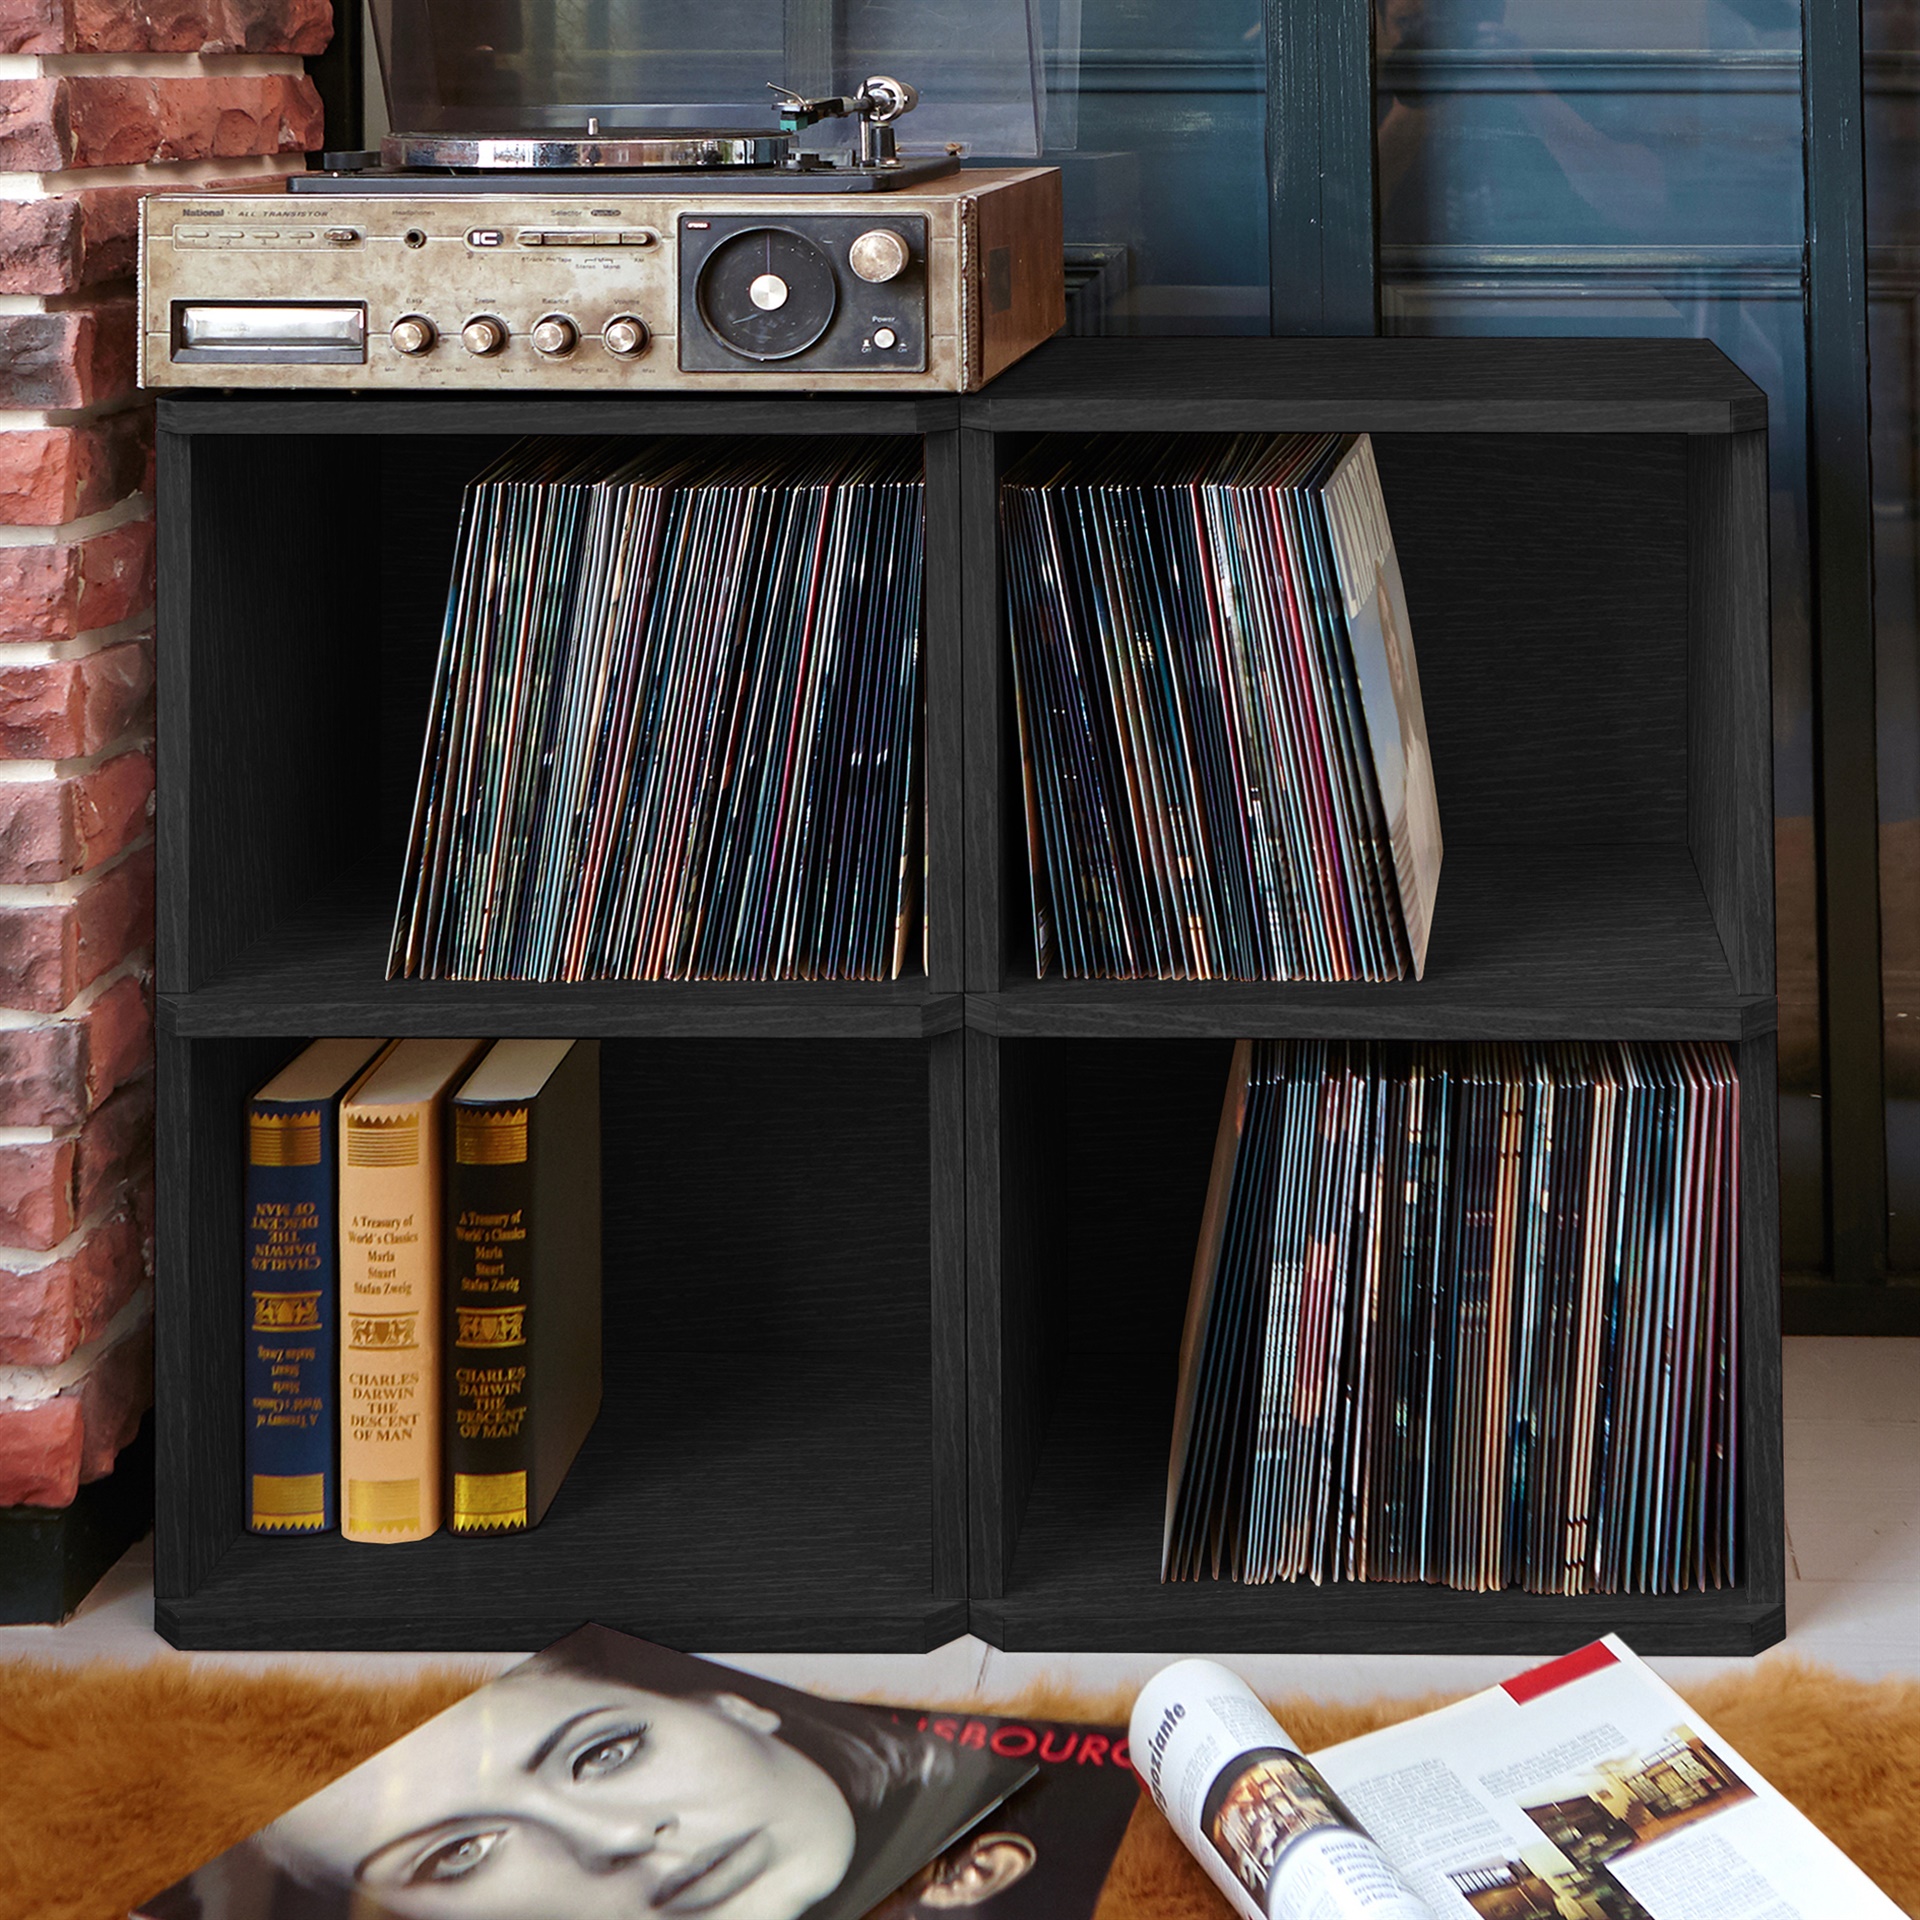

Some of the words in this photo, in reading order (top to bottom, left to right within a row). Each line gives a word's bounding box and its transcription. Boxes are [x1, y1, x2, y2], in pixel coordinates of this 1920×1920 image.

[182, 208, 225, 217] National
[237, 210, 257, 218] ALL
[262, 210, 329, 218] TRANSISTOR
[392, 209, 436, 217] Headphones
[551, 209, 583, 217] Selector
[472, 231, 499, 246] IC
[872, 315, 896, 323] Power
[256, 1203, 291, 1216] MAN
[459, 1211, 467, 1225] A
[510, 1209, 523, 1224] of
[352, 1215, 359, 1227] A
[361, 1216, 400, 1231] Treasury
[403, 1214, 414, 1227] of
[255, 1242, 317, 1257] DARWIN
[252, 1256, 321, 1271] CHARLES
[368, 1267, 396, 1279] Stuart
[383, 1281, 412, 1297] Zweig
[349, 1373, 419, 1386] CHARLES
[456, 1366, 526, 1383] CHARLES
[352, 1386, 414, 1399] DARWIN
[459, 1381, 521, 1396] DARWIN
[367, 1402, 399, 1414] THE
[474, 1396, 506, 1411] THE
[350, 1413, 420, 1428] DESCENT
[456, 1406, 527, 1424] DESCENT
[353, 1429, 372, 1441] OF
[376, 1428, 413, 1441] MAN
[460, 1424, 480, 1438] OF
[482, 1421, 520, 1438] MAN
[1147, 1703, 1186, 1815] goziante
